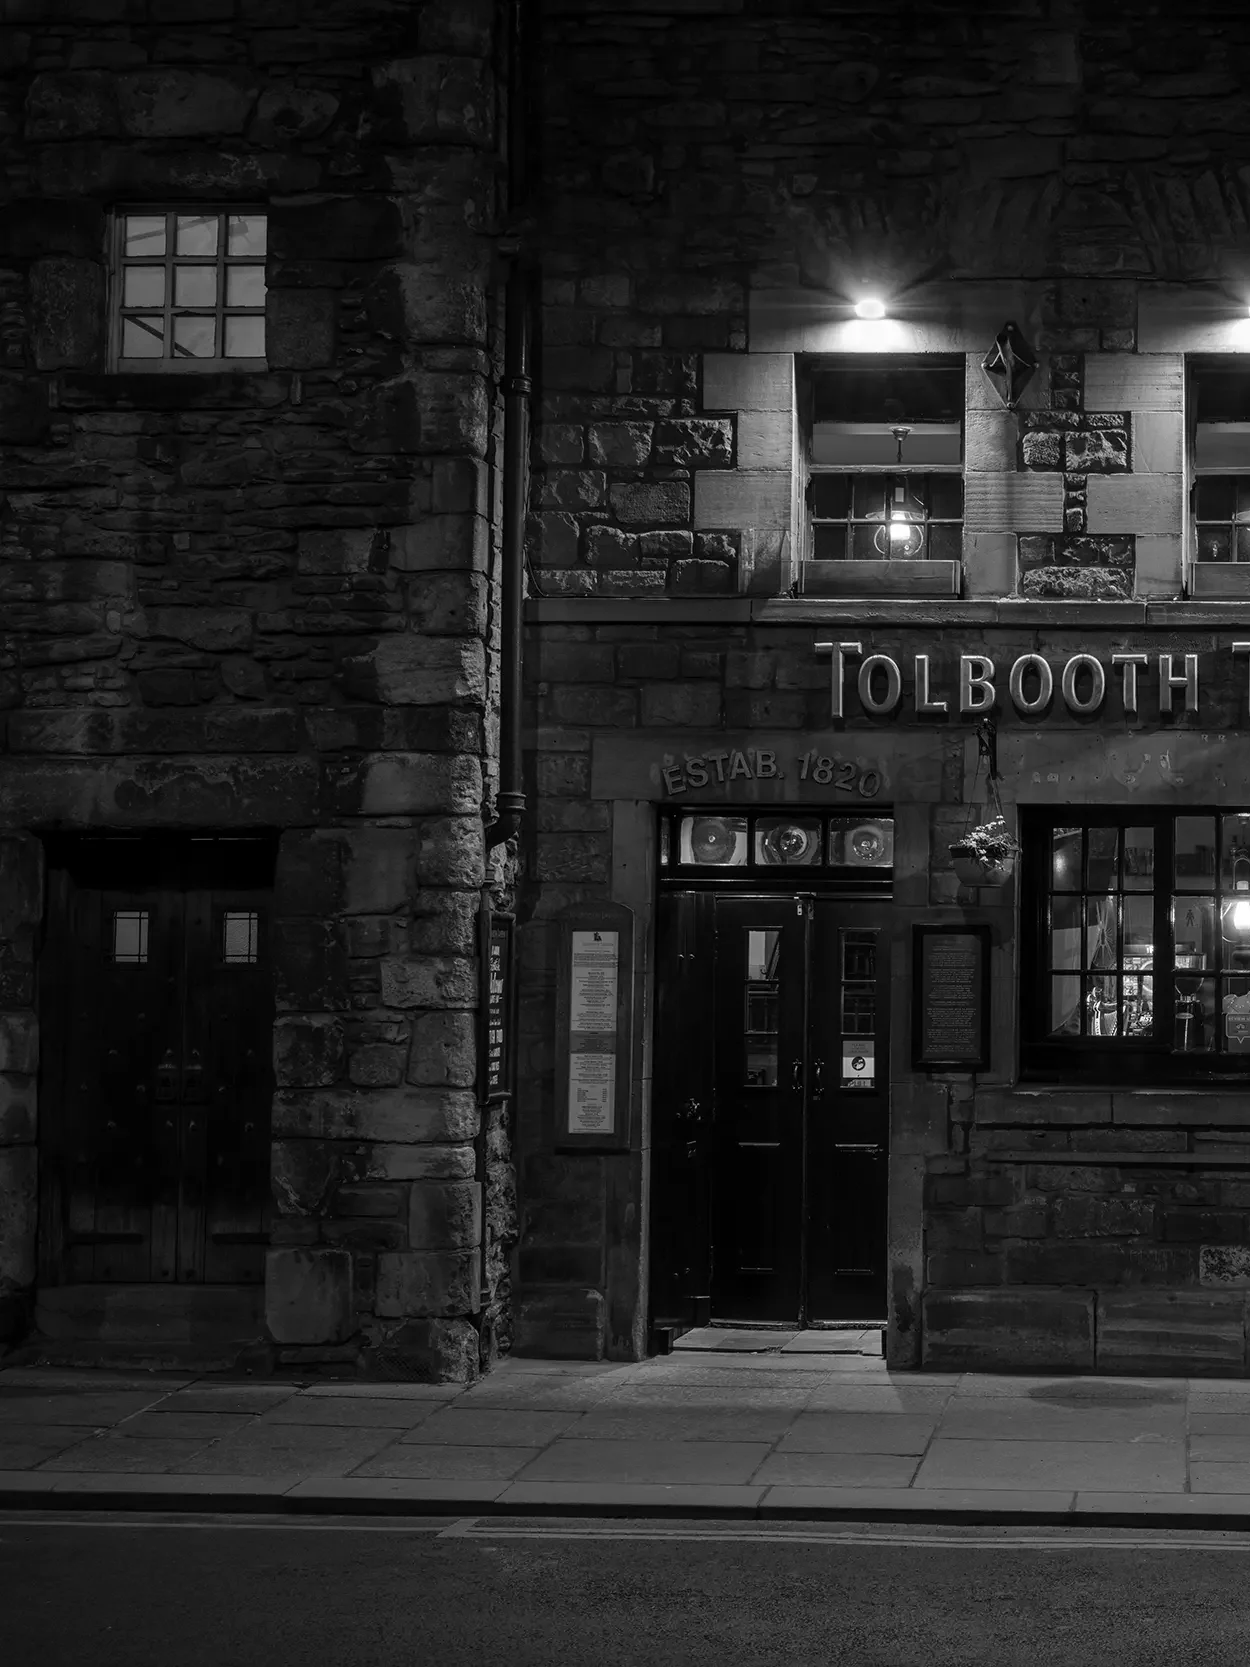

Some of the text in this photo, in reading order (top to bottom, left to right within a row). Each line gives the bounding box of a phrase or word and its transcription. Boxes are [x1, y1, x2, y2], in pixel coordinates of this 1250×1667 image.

[813, 641, 1199, 719] TOLBOOTH
[661, 749, 882, 798] ESTAB. 1820
